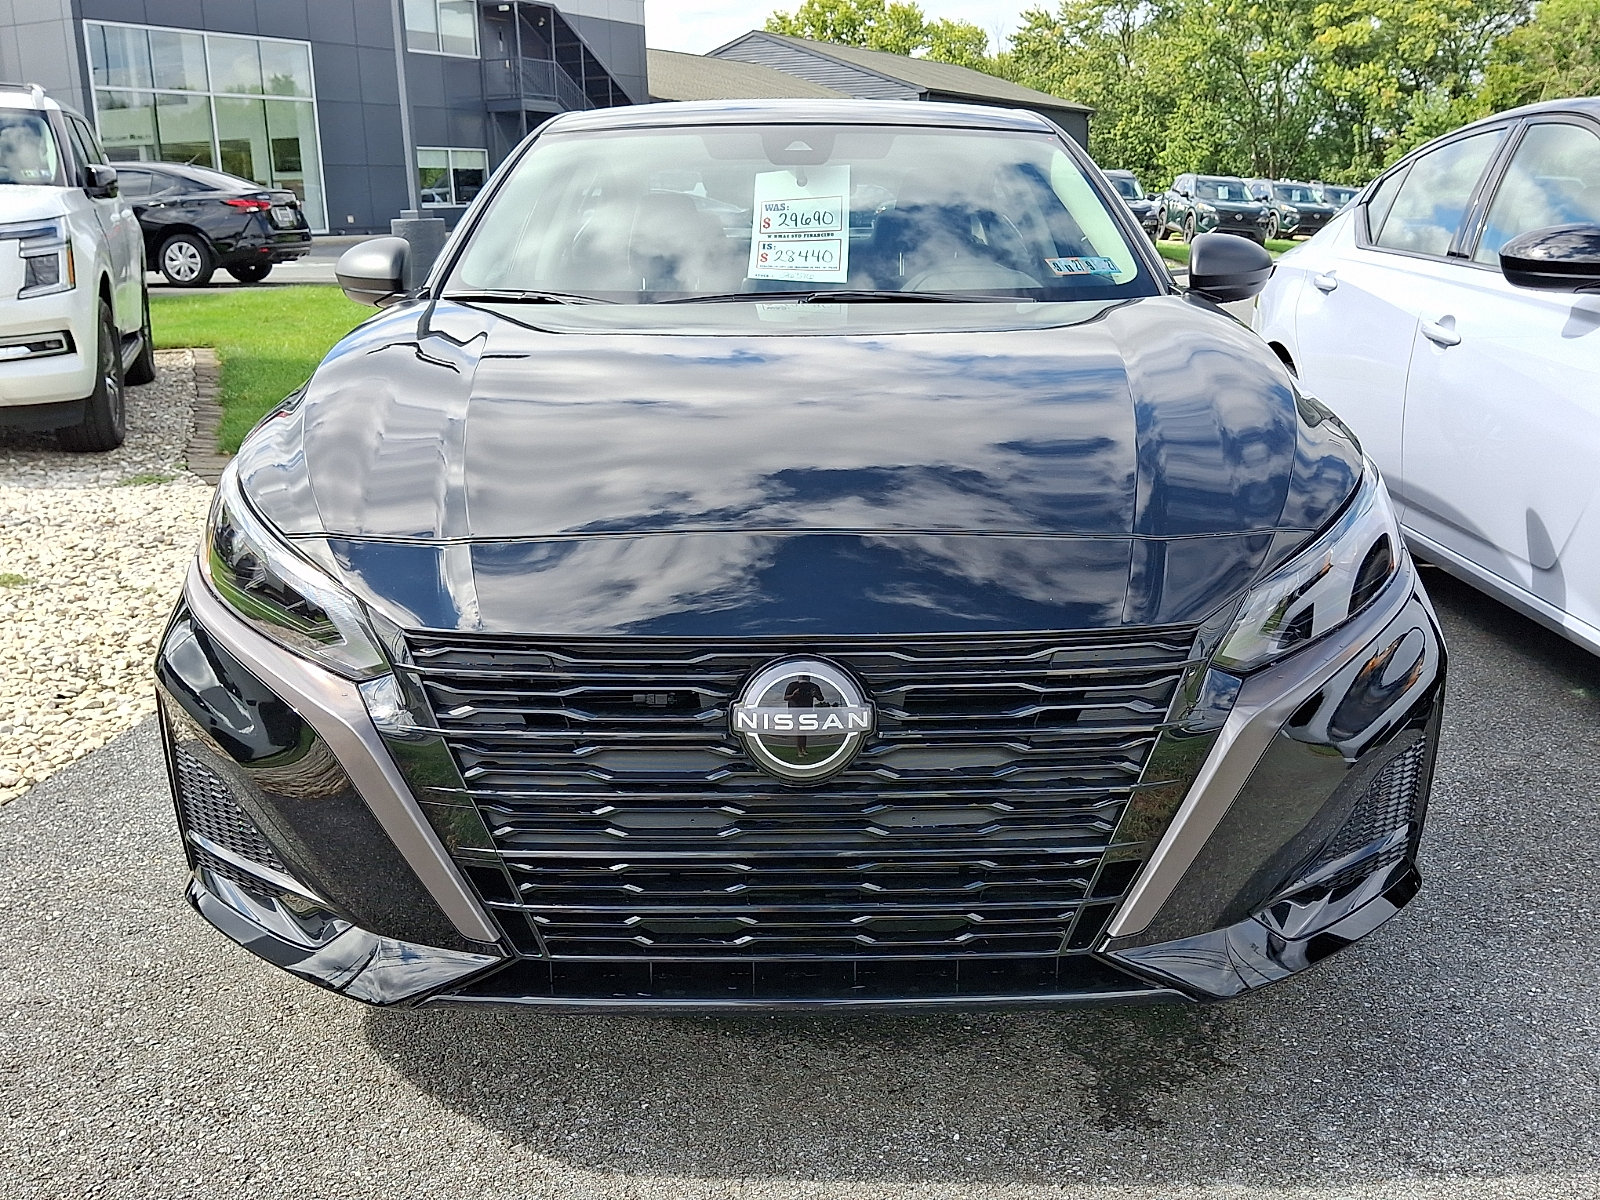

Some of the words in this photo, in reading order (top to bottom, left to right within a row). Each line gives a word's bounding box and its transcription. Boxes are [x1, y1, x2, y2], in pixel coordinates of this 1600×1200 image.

[764, 203, 790, 211] WAS:
[778, 210, 834, 227] 29690
[762, 243, 776, 251] IS:
[774, 249, 834, 263] 28440
[737, 711, 868, 731] NISSAN
